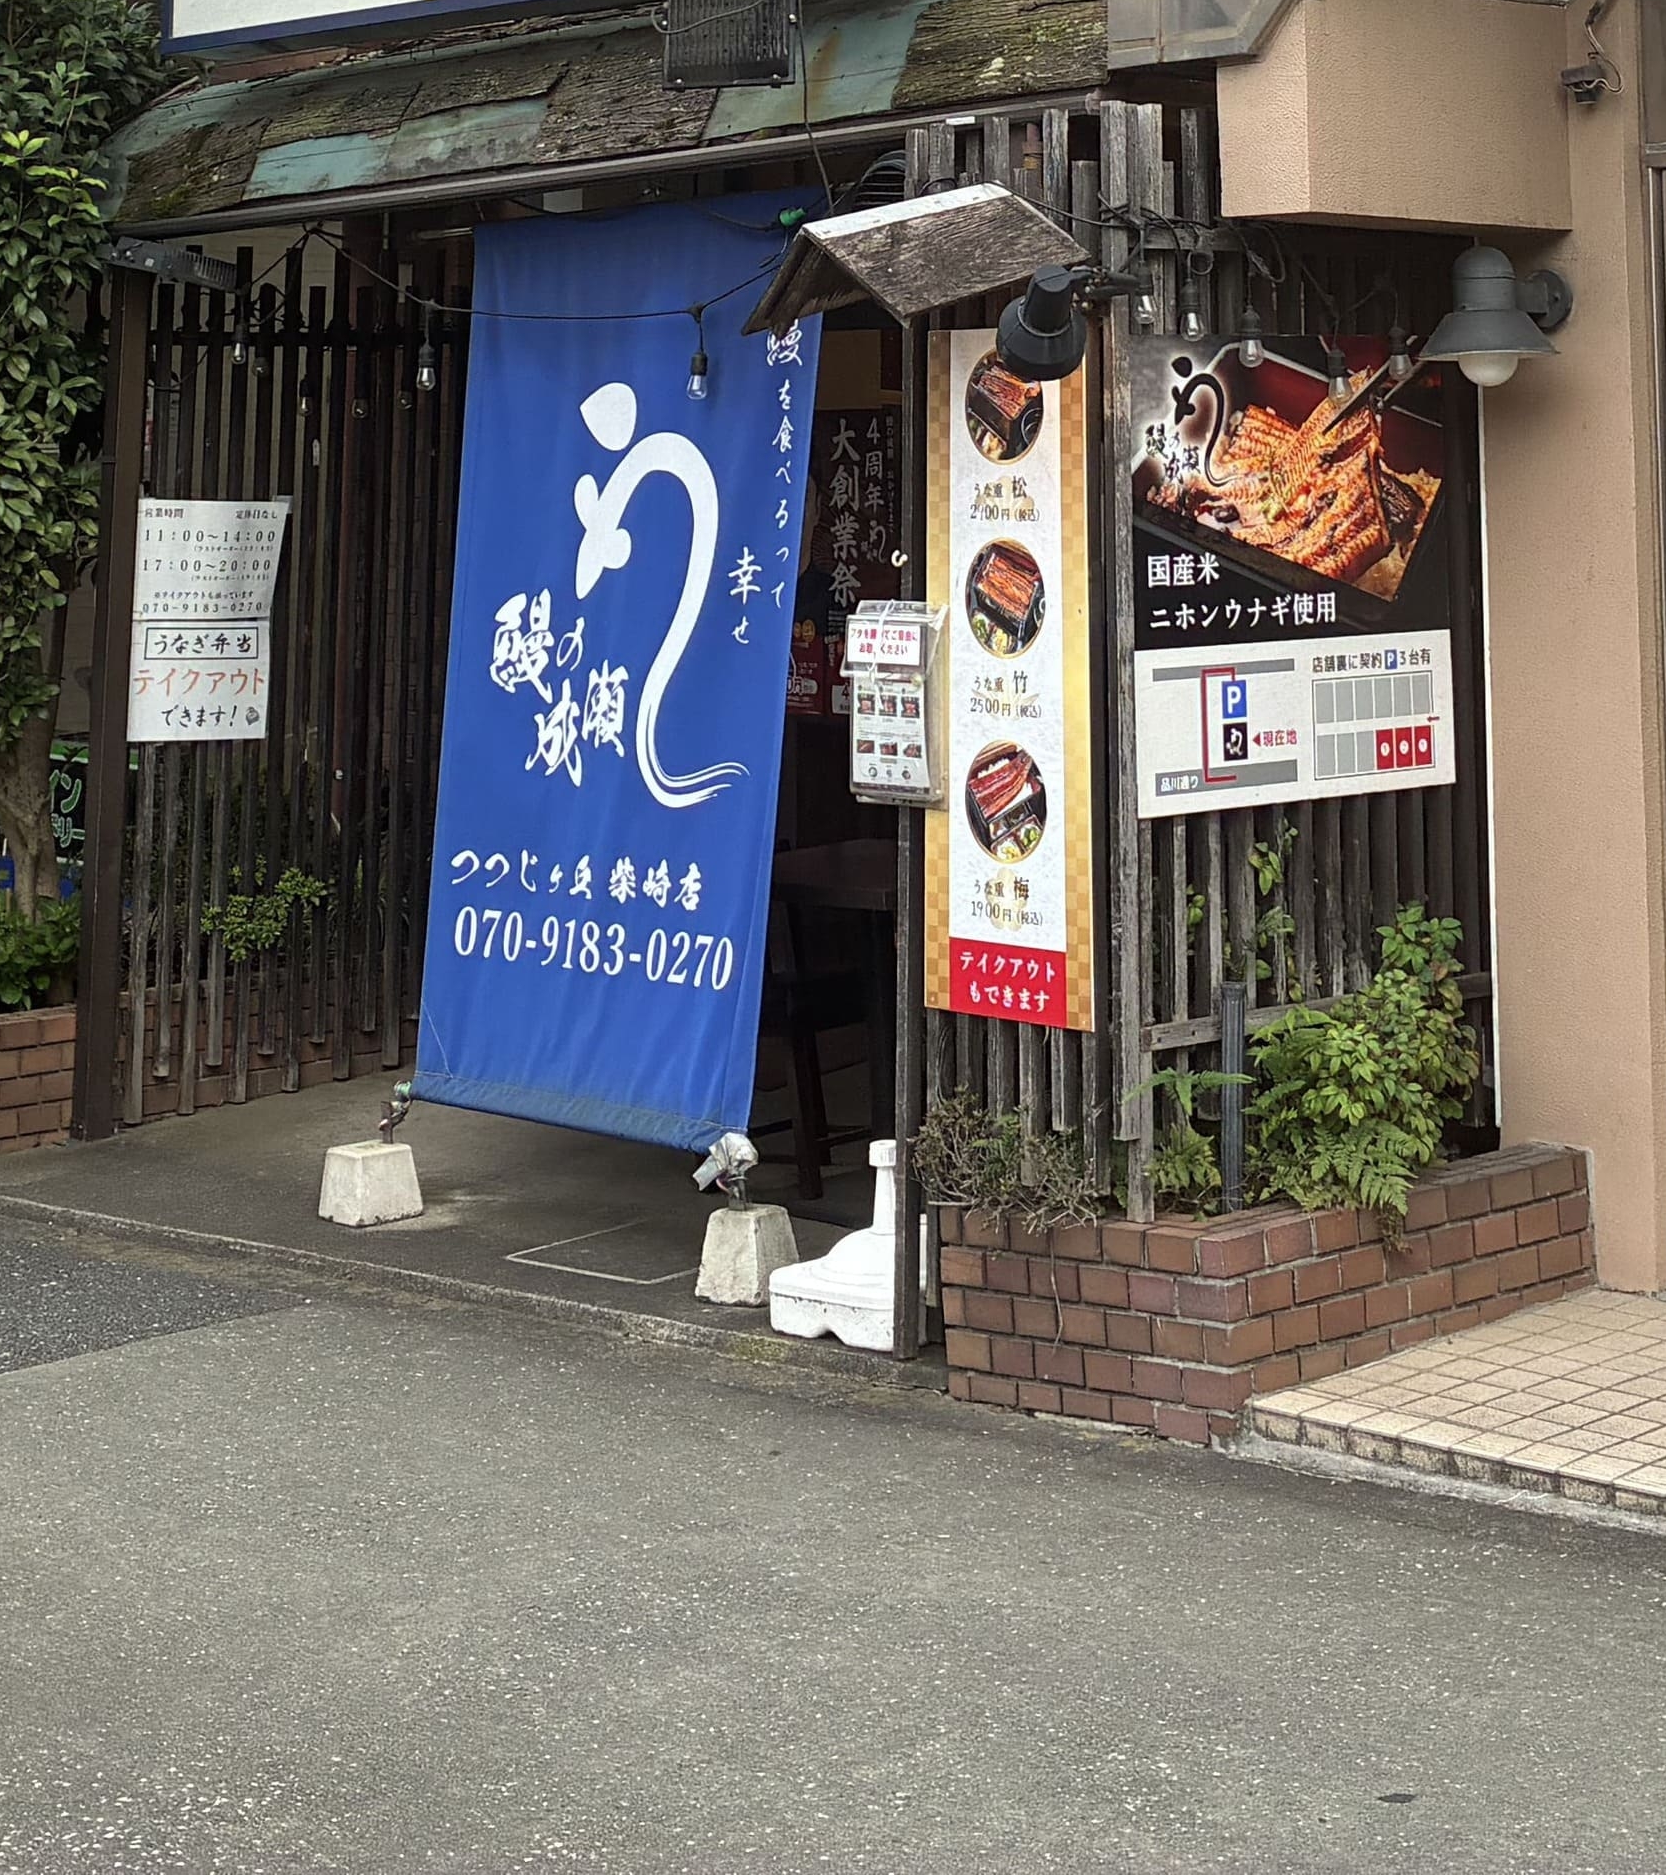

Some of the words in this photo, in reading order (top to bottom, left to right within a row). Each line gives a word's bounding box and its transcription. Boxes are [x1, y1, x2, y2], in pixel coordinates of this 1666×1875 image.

[1012, 475, 1028, 498] 松
[1147, 552, 1220, 588] 国産米
[729, 547, 763, 644] 幸せ
[1149, 592, 1336, 631] ニホンウナギ使用
[153, 633, 253, 654] うなぎ弁当
[133, 668, 265, 697] テイクアウト
[1013, 670, 1029, 694] 竹
[1263, 730, 1298, 747] 現在地
[1013, 876, 1030, 901] 梅
[453, 906, 734, 991] 070-9183-0270
[960, 951, 1056, 982] テイクアウト
[969, 981, 1051, 1013] もできます
